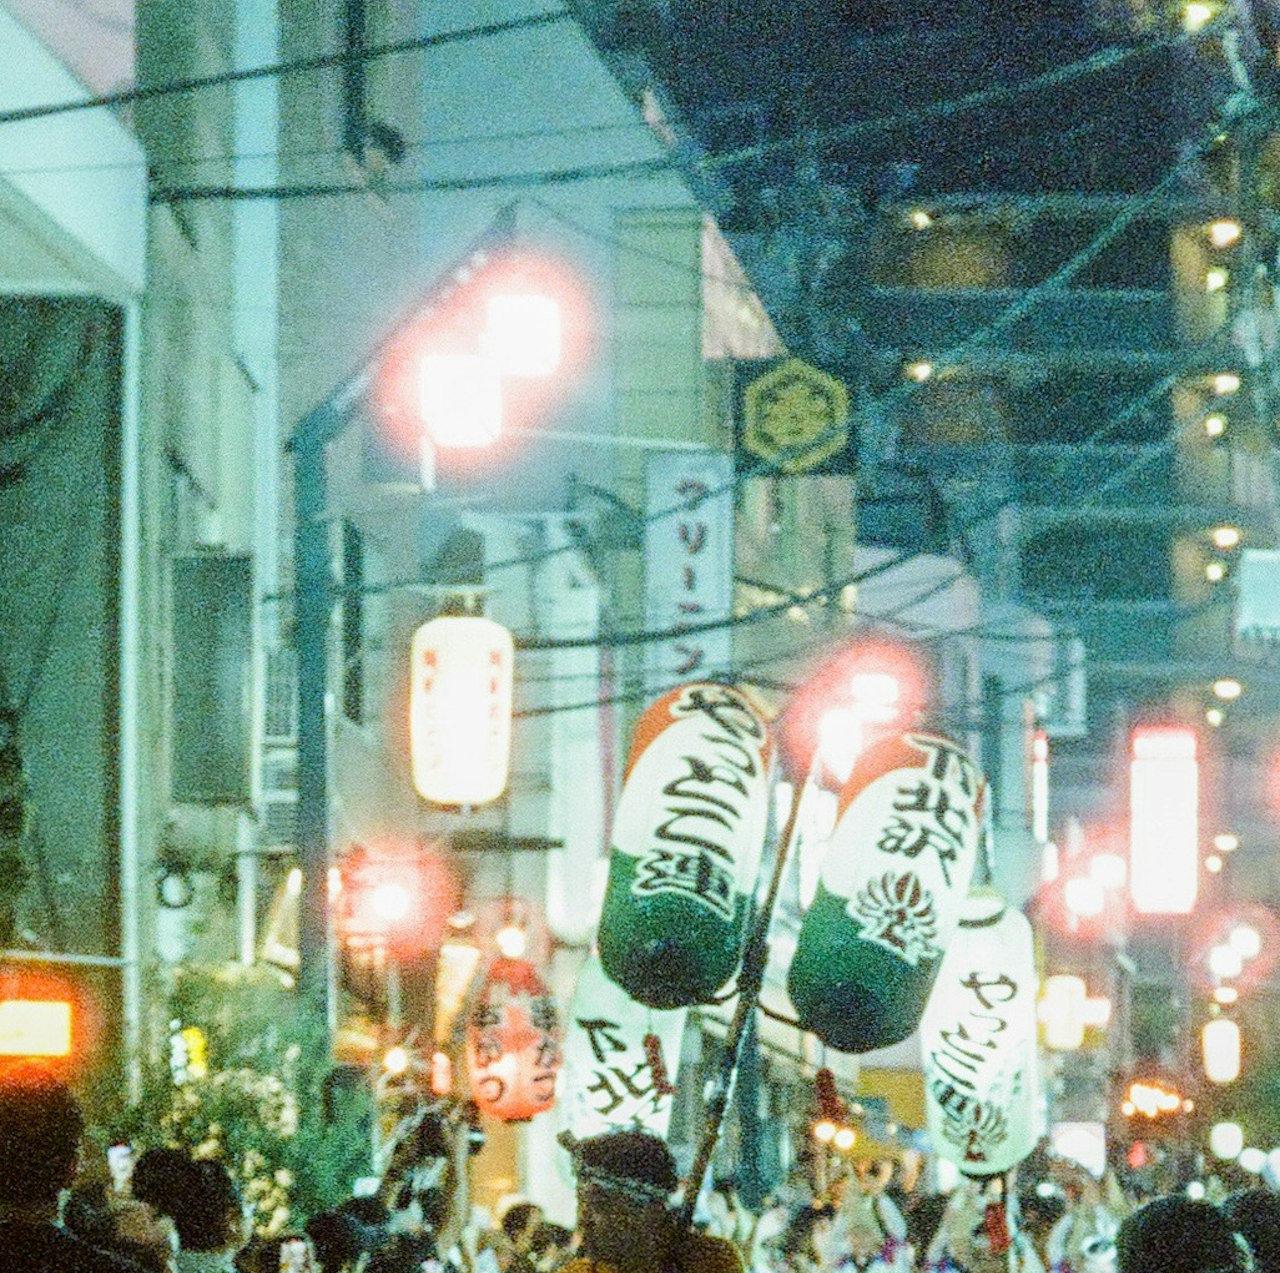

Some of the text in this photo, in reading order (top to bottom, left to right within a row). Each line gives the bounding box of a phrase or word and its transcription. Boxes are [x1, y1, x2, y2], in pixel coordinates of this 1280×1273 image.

[877, 736, 978, 887] 下北沢
[575, 1017, 666, 1132] 下北
